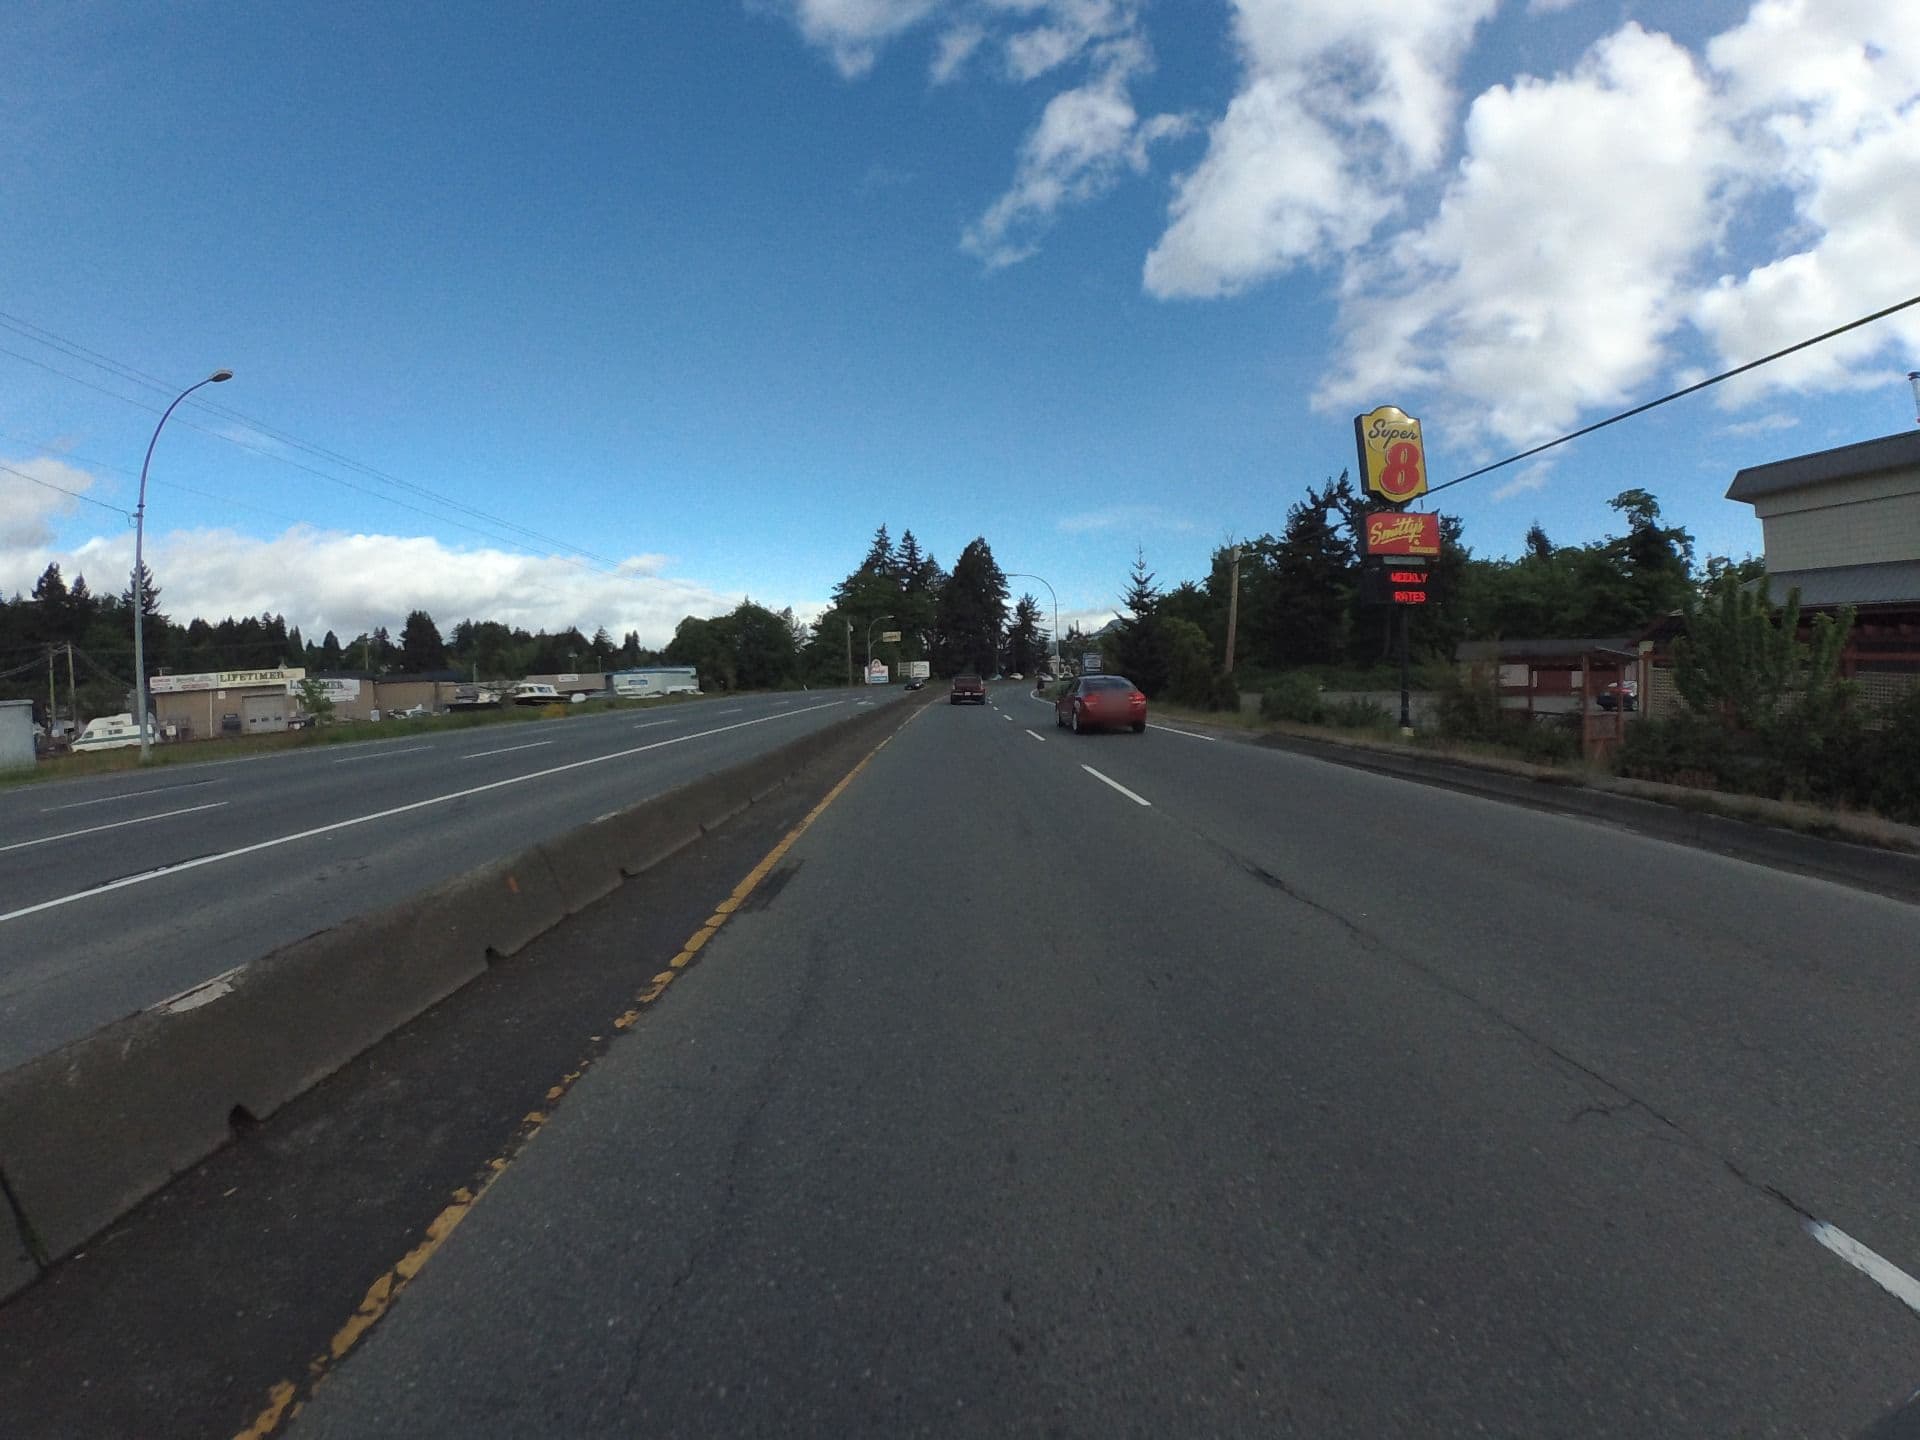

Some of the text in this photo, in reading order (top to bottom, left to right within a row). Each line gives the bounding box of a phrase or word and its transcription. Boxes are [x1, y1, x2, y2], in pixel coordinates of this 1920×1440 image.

[1368, 418, 1418, 449] Super
[1380, 442, 1420, 495] 8
[1369, 517, 1425, 545] Smitty's
[1391, 572, 1428, 583] WEEKLY
[1394, 591, 1426, 602] RATES
[219, 671, 285, 683] LIFETIMER
